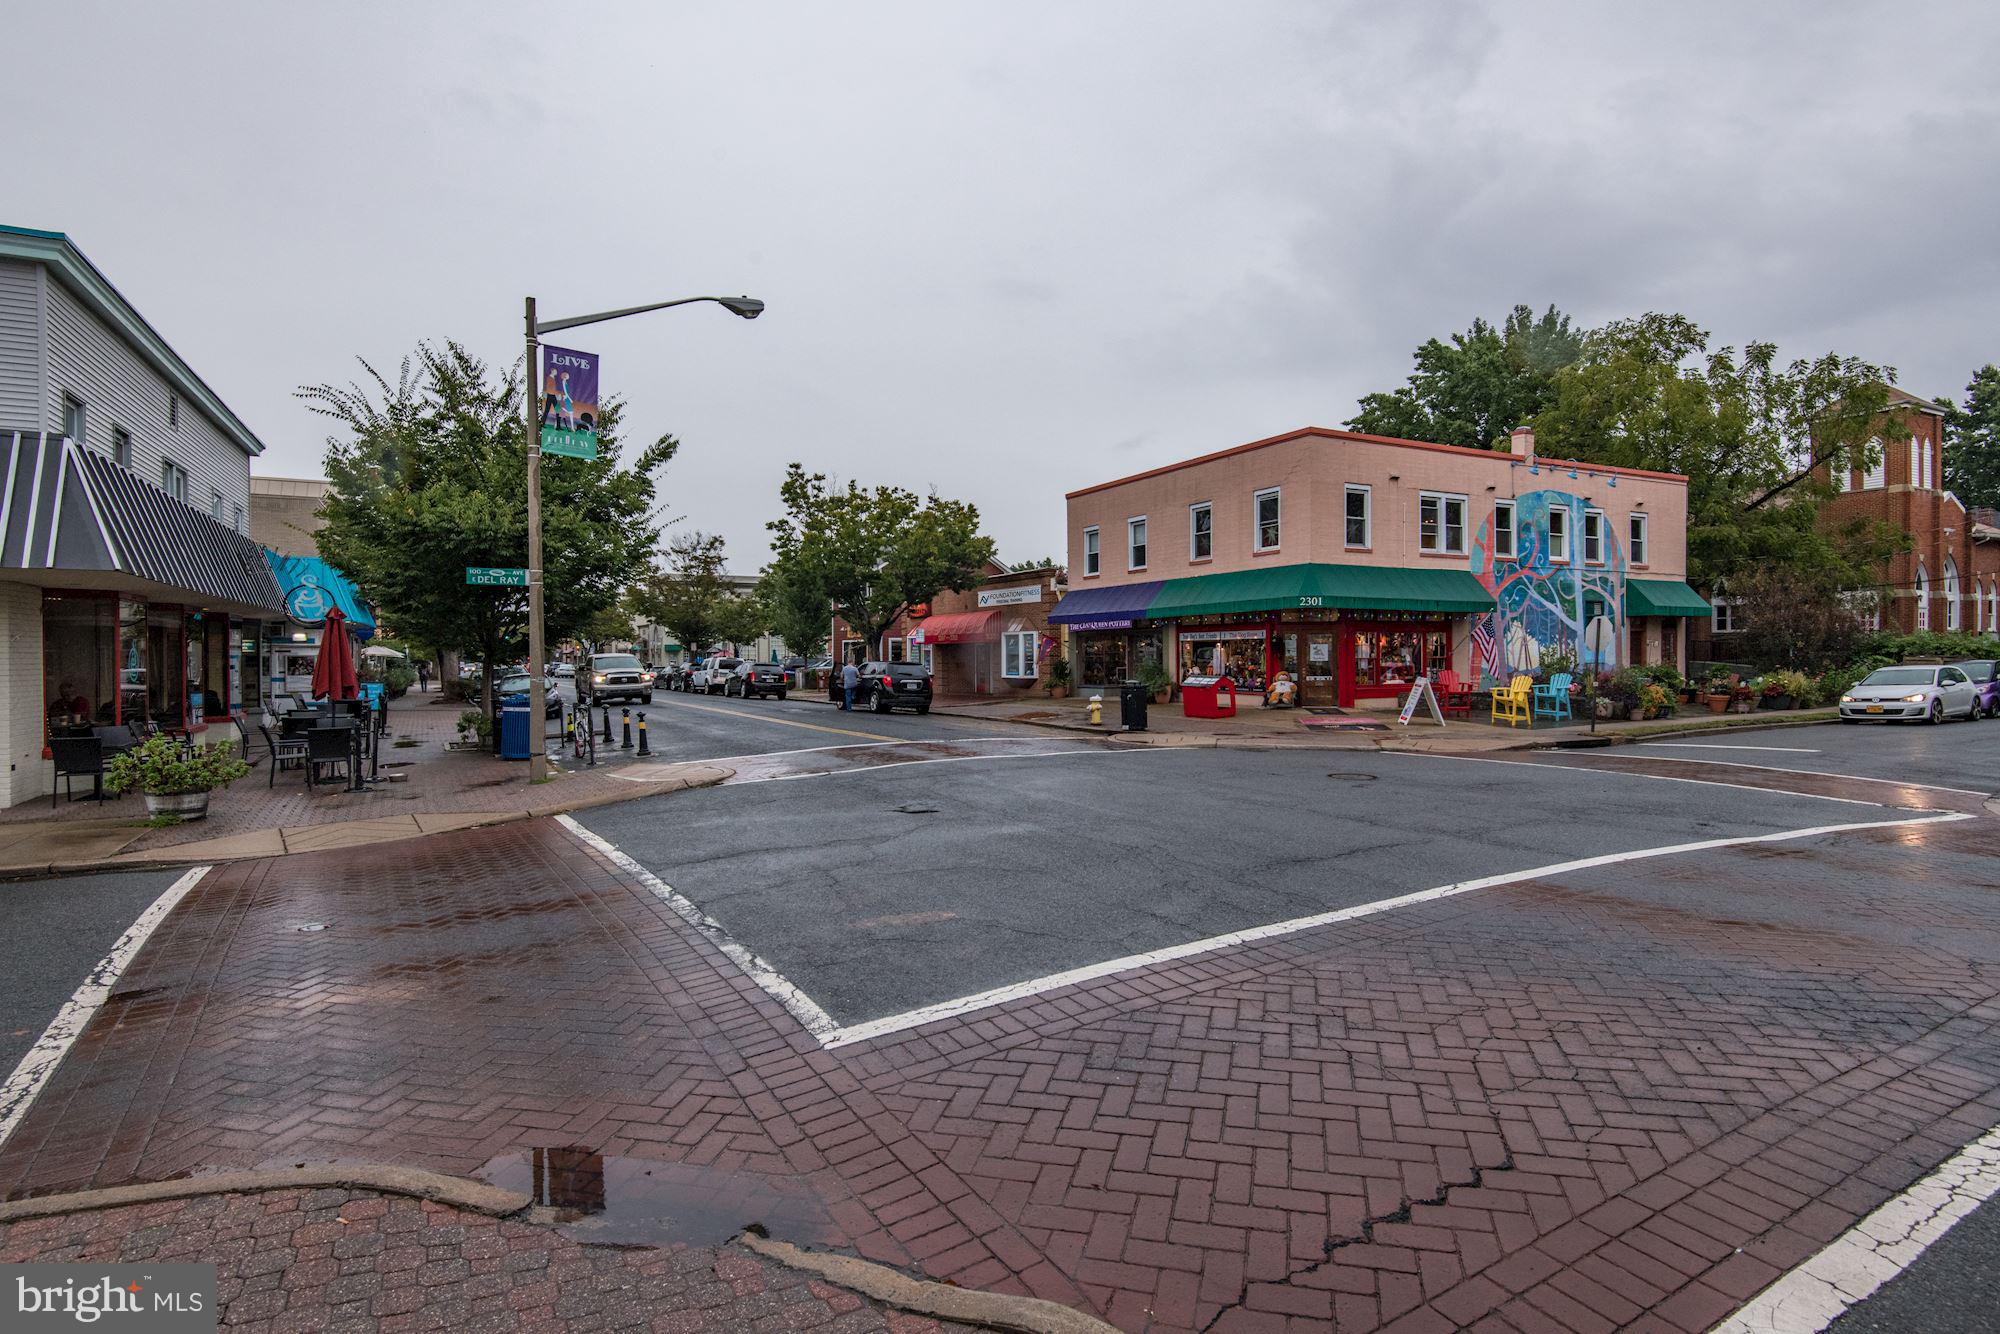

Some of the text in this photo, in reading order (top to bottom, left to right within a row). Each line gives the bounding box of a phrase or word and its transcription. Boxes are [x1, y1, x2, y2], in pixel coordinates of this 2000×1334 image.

[551, 353, 590, 370] LIVE
[477, 575, 497, 584] DEL
[1299, 596, 1322, 606] 2301
